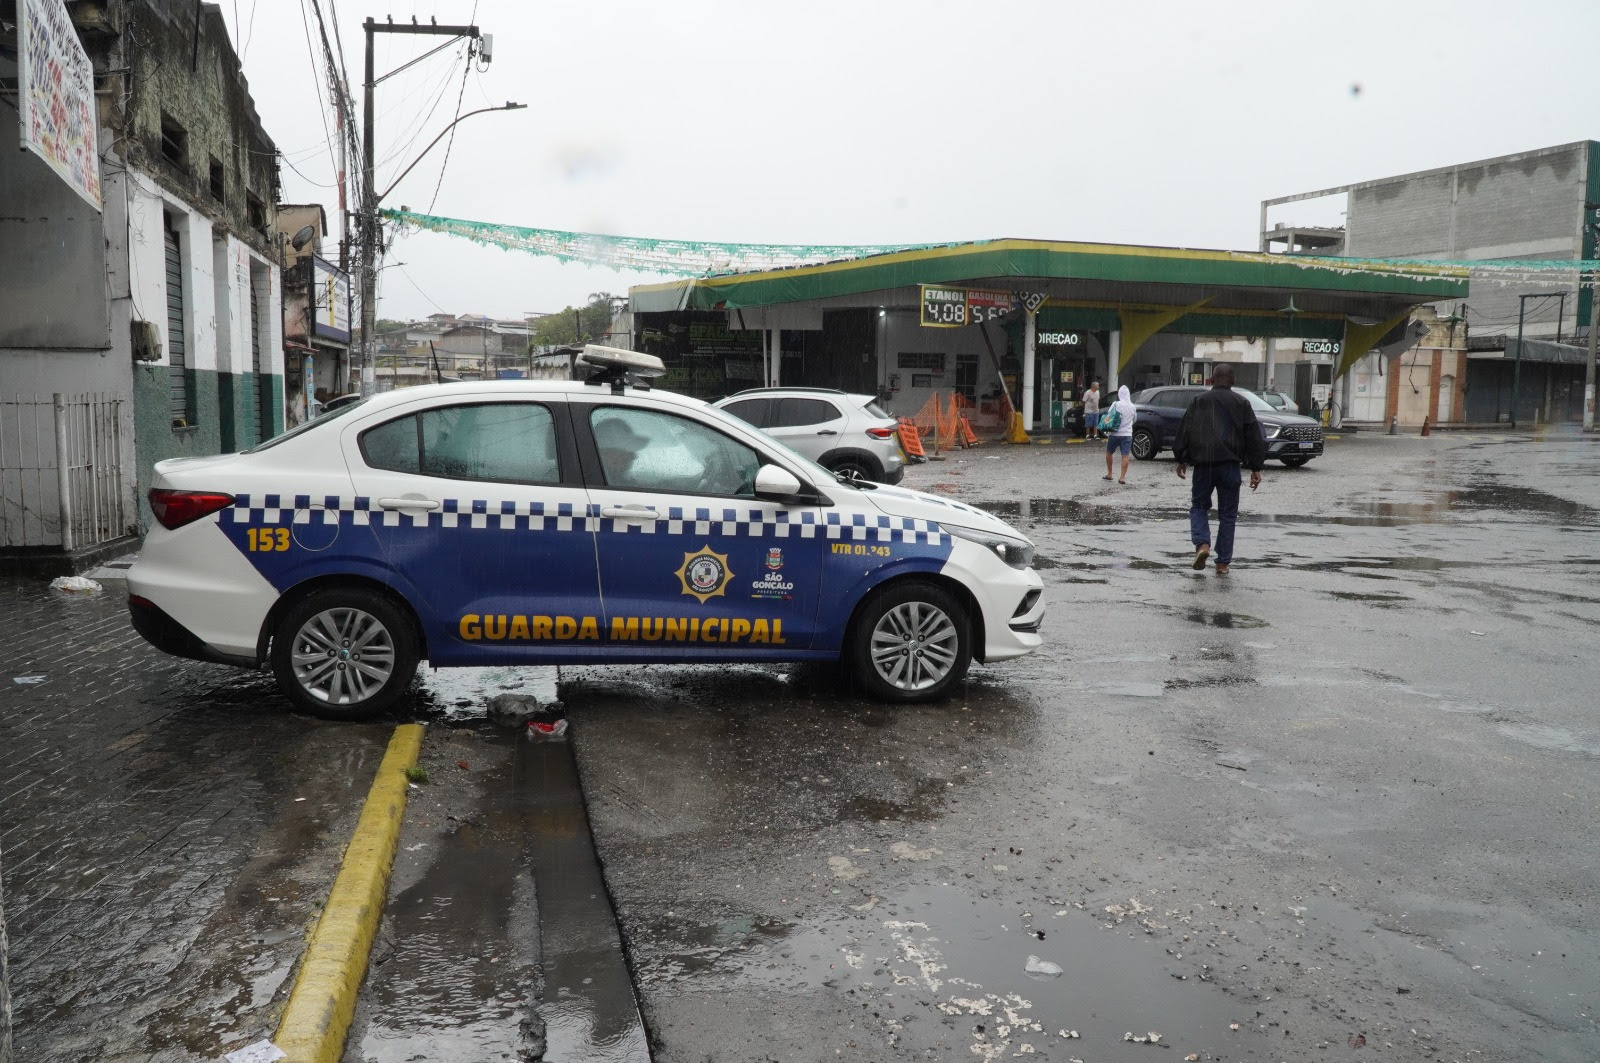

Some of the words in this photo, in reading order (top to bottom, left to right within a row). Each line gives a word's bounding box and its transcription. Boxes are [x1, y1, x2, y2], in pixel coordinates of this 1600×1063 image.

[925, 290, 965, 302] ETANOL
[968, 291, 1008, 302] GASOLINA
[928, 303, 965, 323] 4,08
[247, 527, 290, 552] 153
[831, 543, 852, 555] VTR
[764, 572, 783, 581] SÃO
[752, 581, 794, 590] GONÇALO
[459, 614, 600, 641] GUARDA
[609, 616, 787, 644] MUNICIPAL
